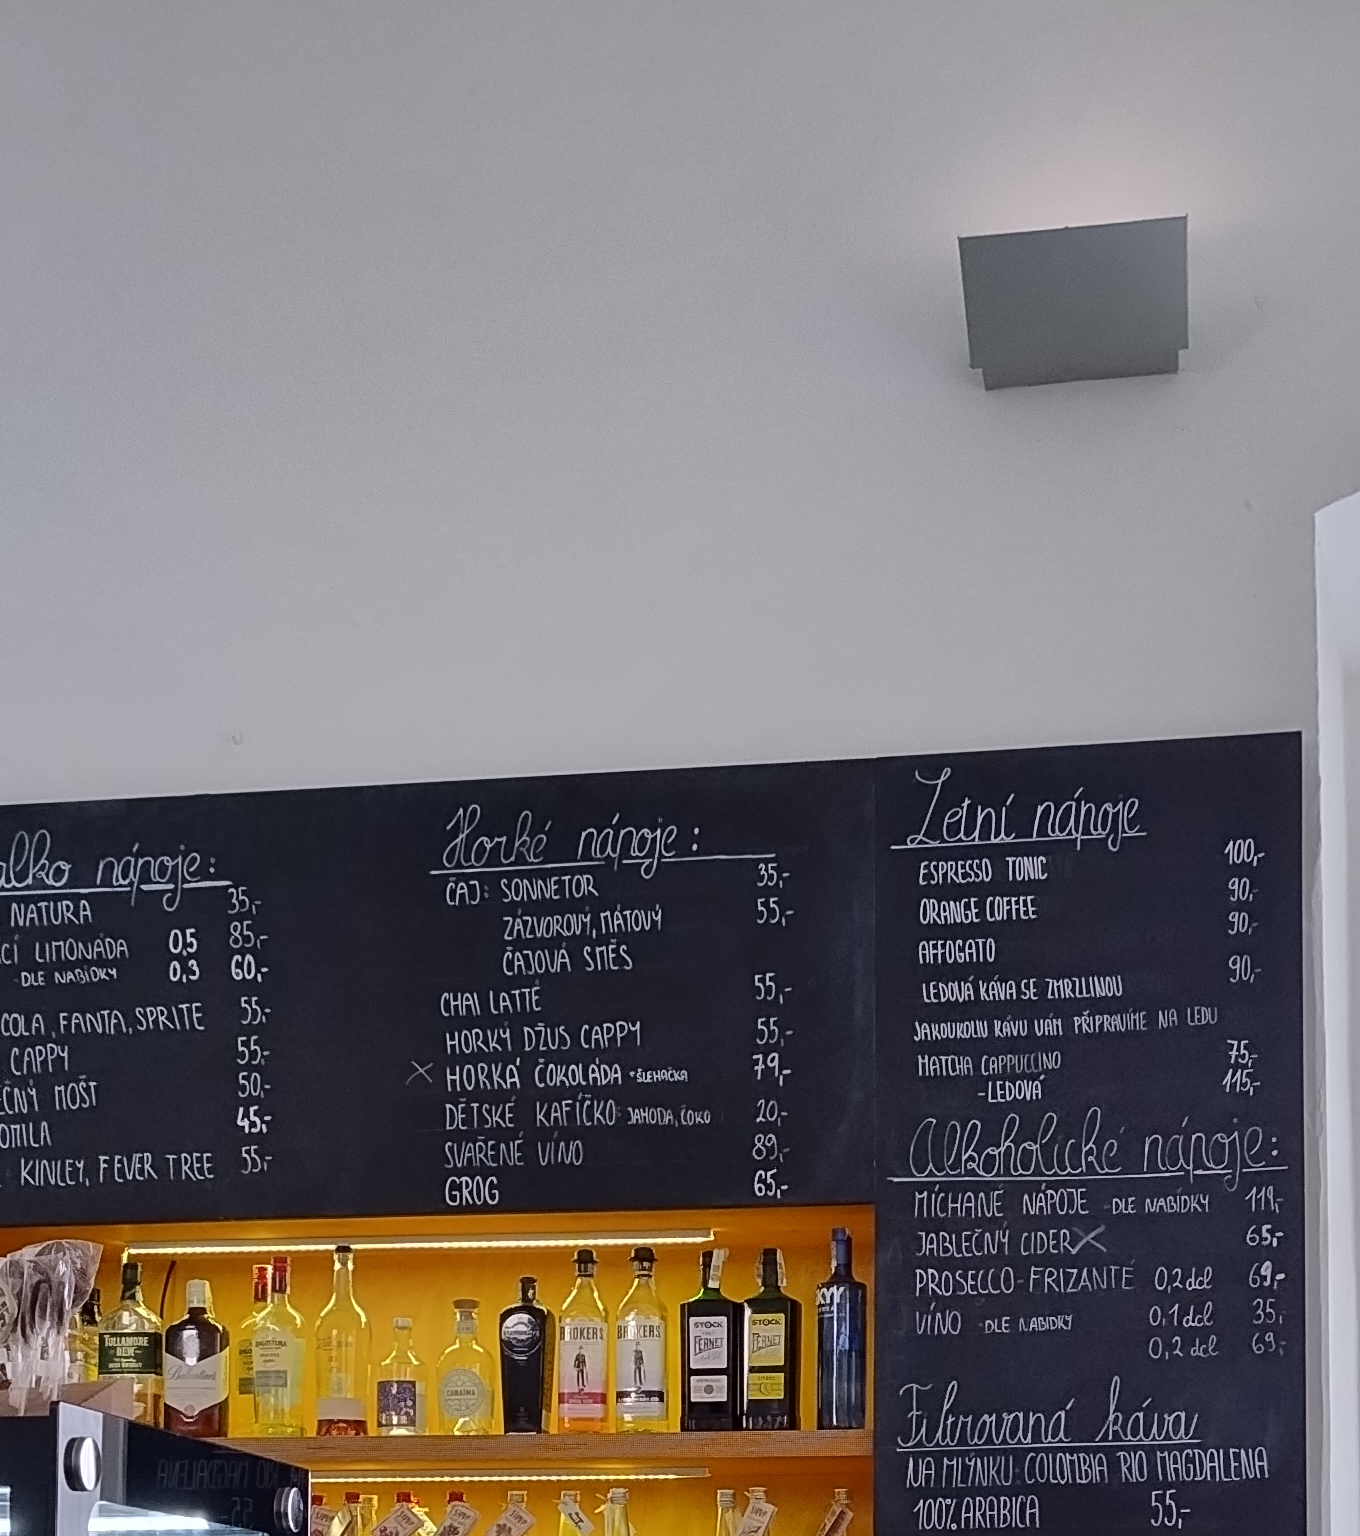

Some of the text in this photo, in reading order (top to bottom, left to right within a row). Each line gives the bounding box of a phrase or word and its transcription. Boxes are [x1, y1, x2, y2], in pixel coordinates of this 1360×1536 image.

[907, 767, 1141, 851] Letní nápoje
[442, 804, 551, 868] Horké
[919, 855, 1048, 885] ESPRESSO TONIC
[501, 874, 599, 902] SONNETOR
[11, 900, 92, 928] NATURA
[600, 904, 662, 935] MÁTOVÝ
[920, 895, 1037, 925] ORANGE COFFEE
[36, 933, 129, 962] LIMONÁDA
[503, 939, 633, 975] ČAJOVÁ SMĚS
[919, 938, 996, 964] AFFOGATO
[169, 960, 199, 983] 0,3
[441, 992, 480, 1017] CHAI
[922, 974, 1123, 1003] LEDOVÁ KÁVA SE ZMRZLINOU
[136, 1003, 205, 1031] SPRITE
[914, 1006, 1218, 1042] JAKOUKOLIV KÁVU VÁM PŘIPRAVÍME NA LEDU
[446, 1021, 641, 1055] HORKÝ DŽUS CAPPY
[11, 1044, 68, 1075] CAPPY
[446, 1058, 622, 1091] HORKÁ ČOKOLÁDA
[918, 1050, 1061, 1077] MATCHA CAPPUCCINO
[55, 1074, 98, 1111] MOŠT
[445, 1095, 711, 1130] DĚTSKÉ ČOKO
[445, 1131, 584, 1168] SVAŘENÉ VÍNO
[909, 1106, 1125, 1177] Alkoholické
[99, 1152, 158, 1182] FEVER
[166, 1152, 214, 1181] TREE
[445, 1175, 500, 1206] GROG
[914, 1182, 1209, 1219] MÍCHANÉ NÁPOJE NABÍDKY
[916, 1221, 1073, 1257] JABLEČNÝ CIDER
[916, 1302, 961, 1335] VÍNO
[898, 1375, 1199, 1448] Filtrovaná káva
[906, 1447, 1269, 1488] NA COLOMBIA RIO MAGDALENA
